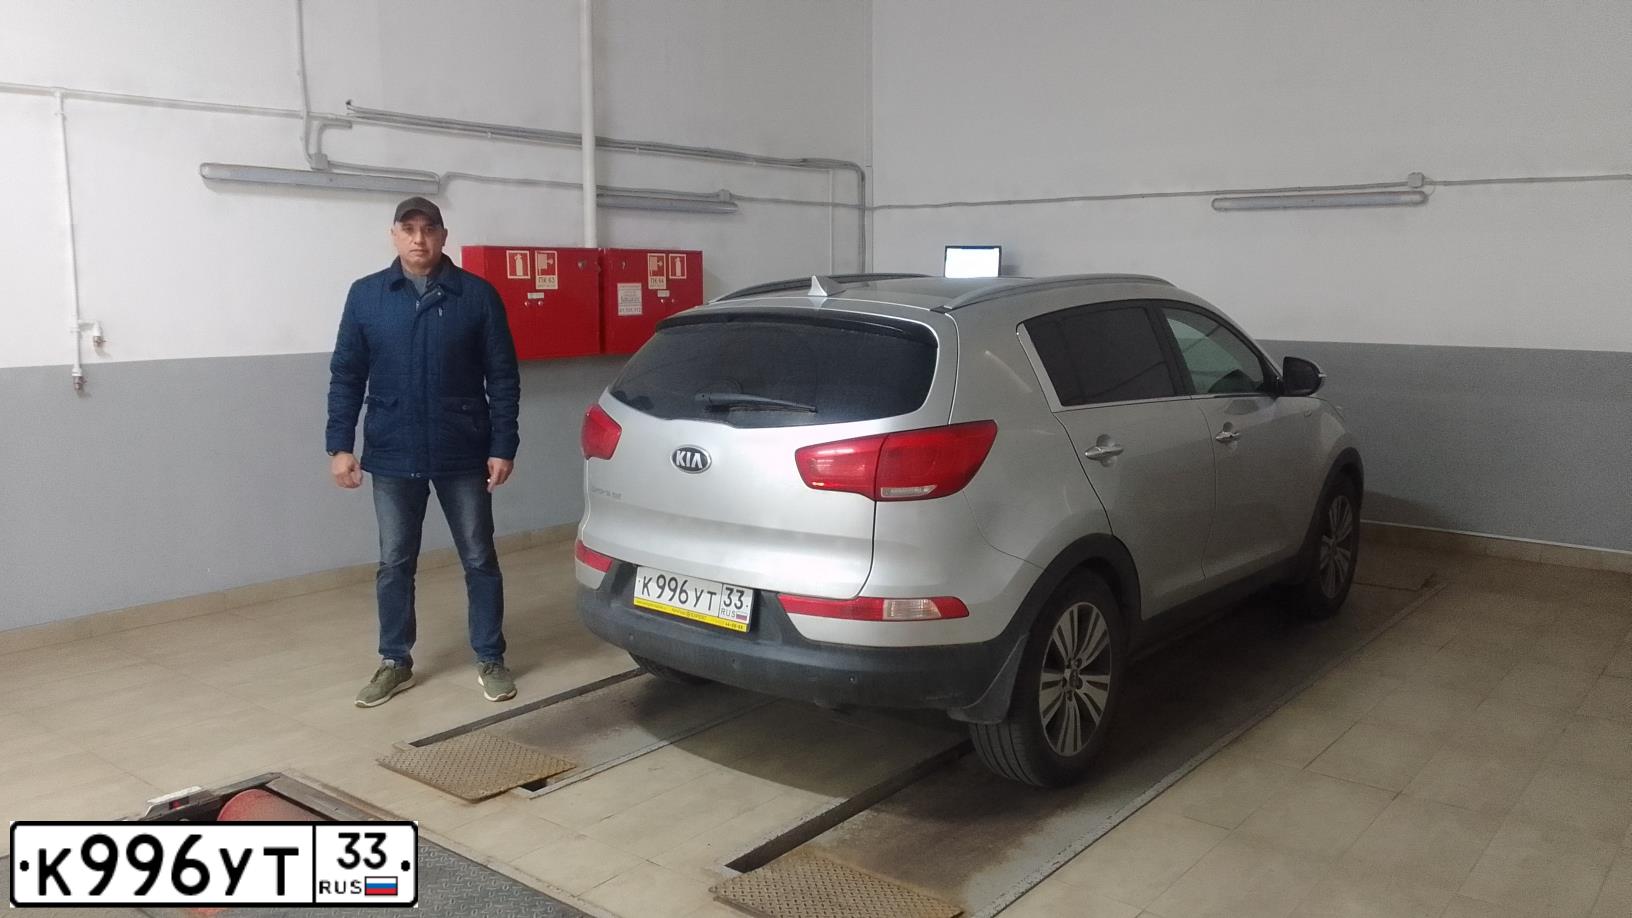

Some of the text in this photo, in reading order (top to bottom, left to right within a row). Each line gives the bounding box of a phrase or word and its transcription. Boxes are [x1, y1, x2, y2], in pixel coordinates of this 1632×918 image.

[676, 450, 703, 469] KIA
[723, 586, 745, 610] 33
[721, 608, 736, 618] RUS
